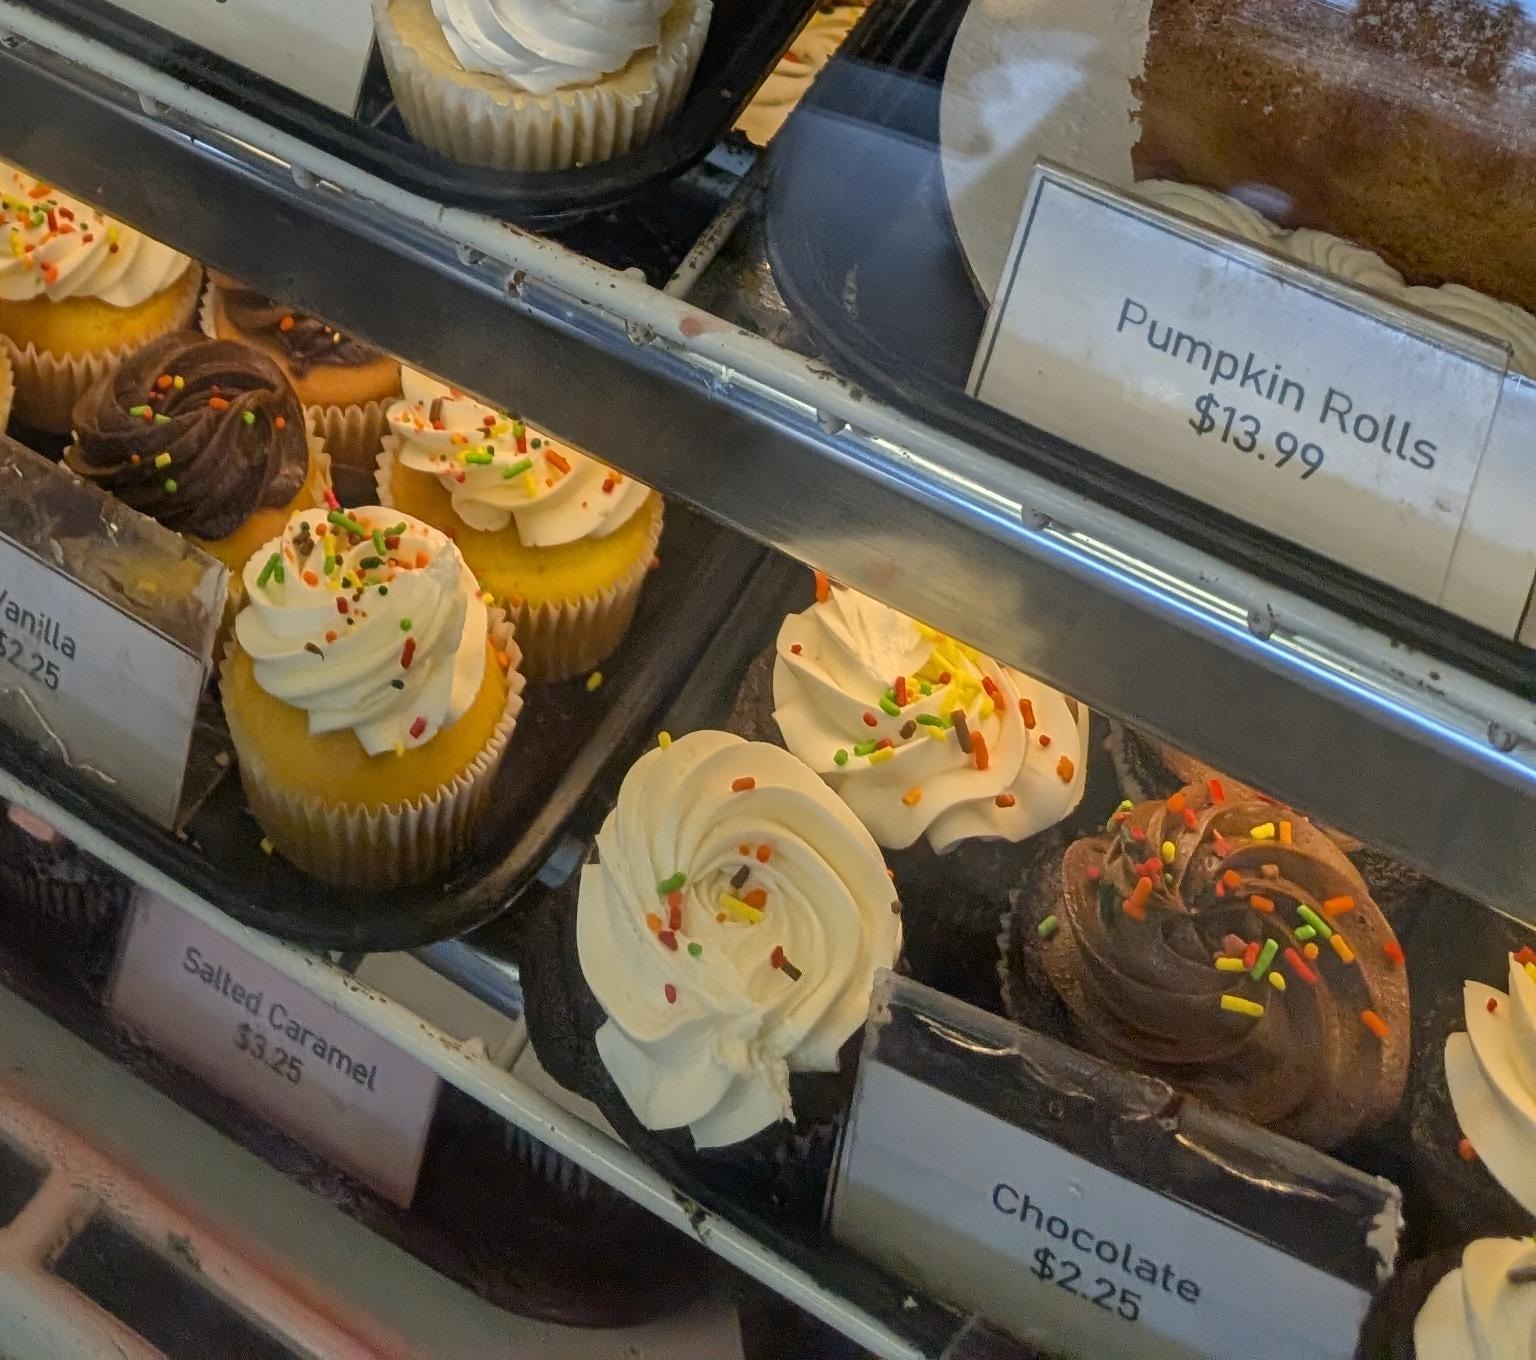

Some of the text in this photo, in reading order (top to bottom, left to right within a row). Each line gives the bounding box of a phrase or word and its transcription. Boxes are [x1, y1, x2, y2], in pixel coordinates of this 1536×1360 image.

[1115, 297, 1438, 471] Pumpkin Rolls
[1189, 392, 1325, 480] $13.99
[182, 945, 378, 1093] Salted Caramel
[232, 1022, 304, 1086] $3.25
[991, 1182, 1202, 1306] Chocolate
[1030, 1246, 1141, 1324] $2.25
